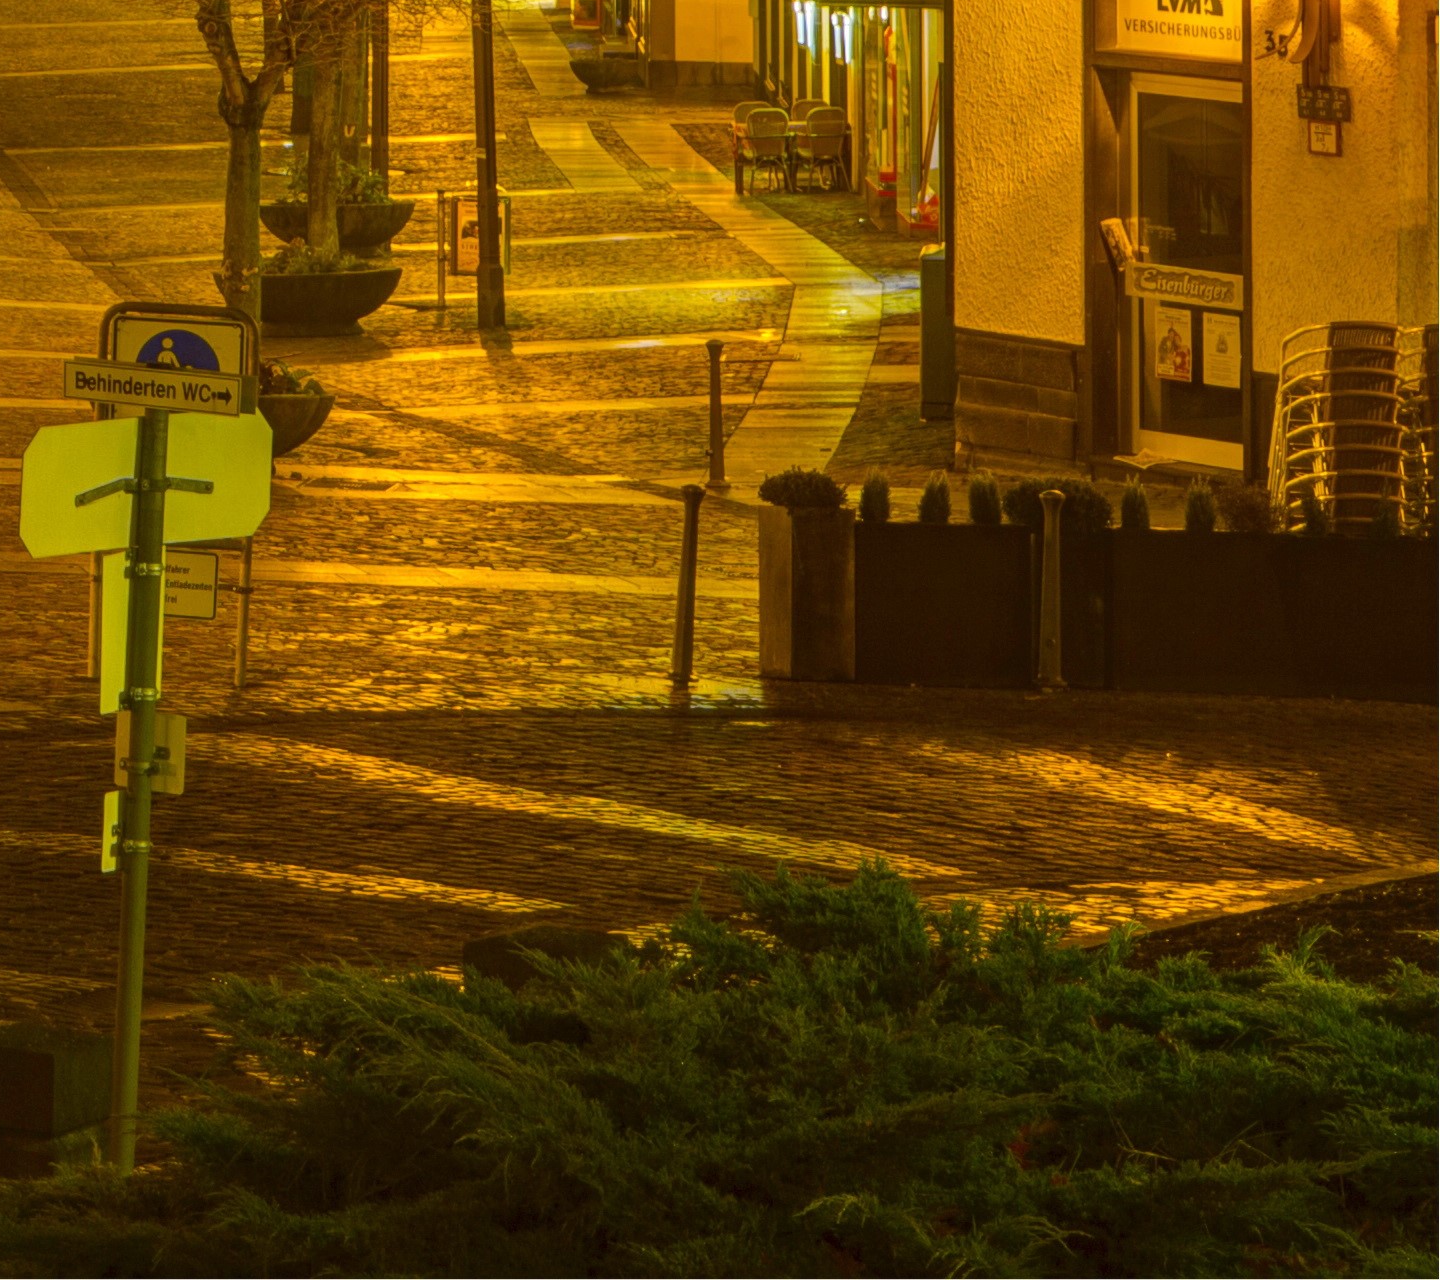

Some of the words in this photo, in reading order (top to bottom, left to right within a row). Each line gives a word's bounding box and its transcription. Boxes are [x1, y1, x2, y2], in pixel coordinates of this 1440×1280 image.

[1123, 17, 1242, 42] VERSICHERUNGSBÜ
[1140, 269, 1228, 301] Eisenbürger
[75, 371, 177, 400] Behinderten
[182, 381, 212, 403] WC
